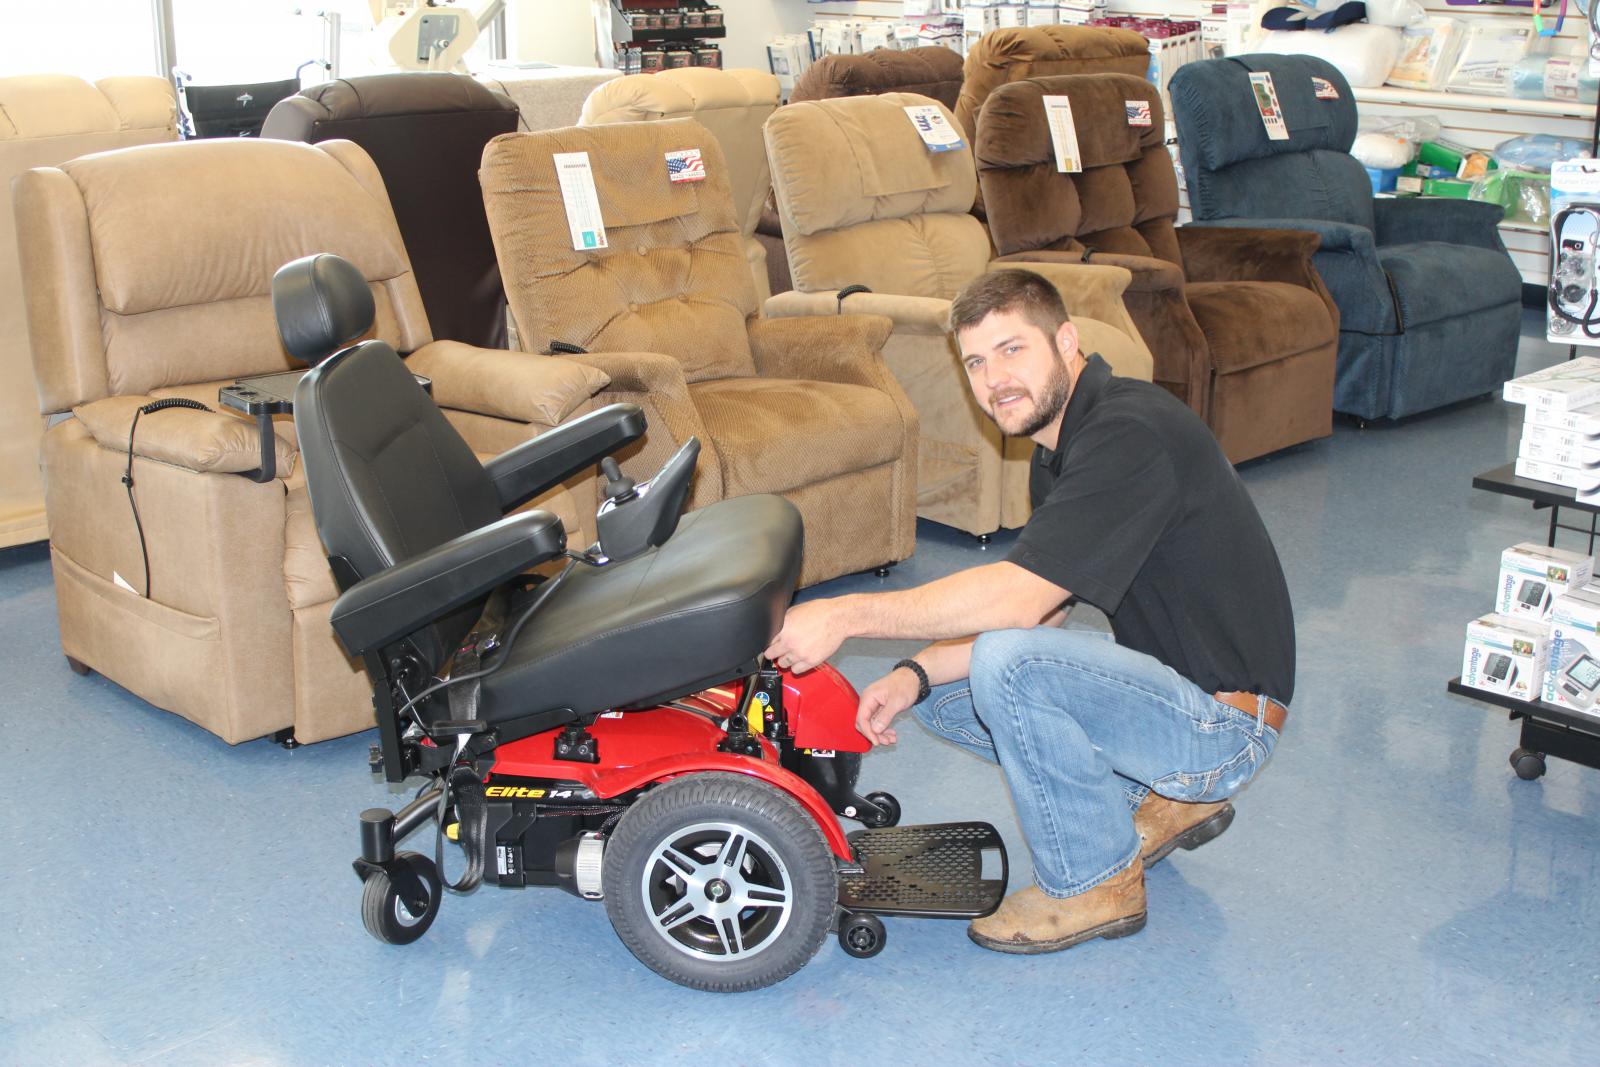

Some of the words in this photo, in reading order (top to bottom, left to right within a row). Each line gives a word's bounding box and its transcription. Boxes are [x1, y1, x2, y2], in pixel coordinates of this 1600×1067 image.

[1502, 575, 1516, 612] advantage
[1467, 647, 1481, 686] advantage
[1544, 629, 1564, 701] advantage
[485, 786, 546, 798] Elite
[549, 790, 573, 798] 14
